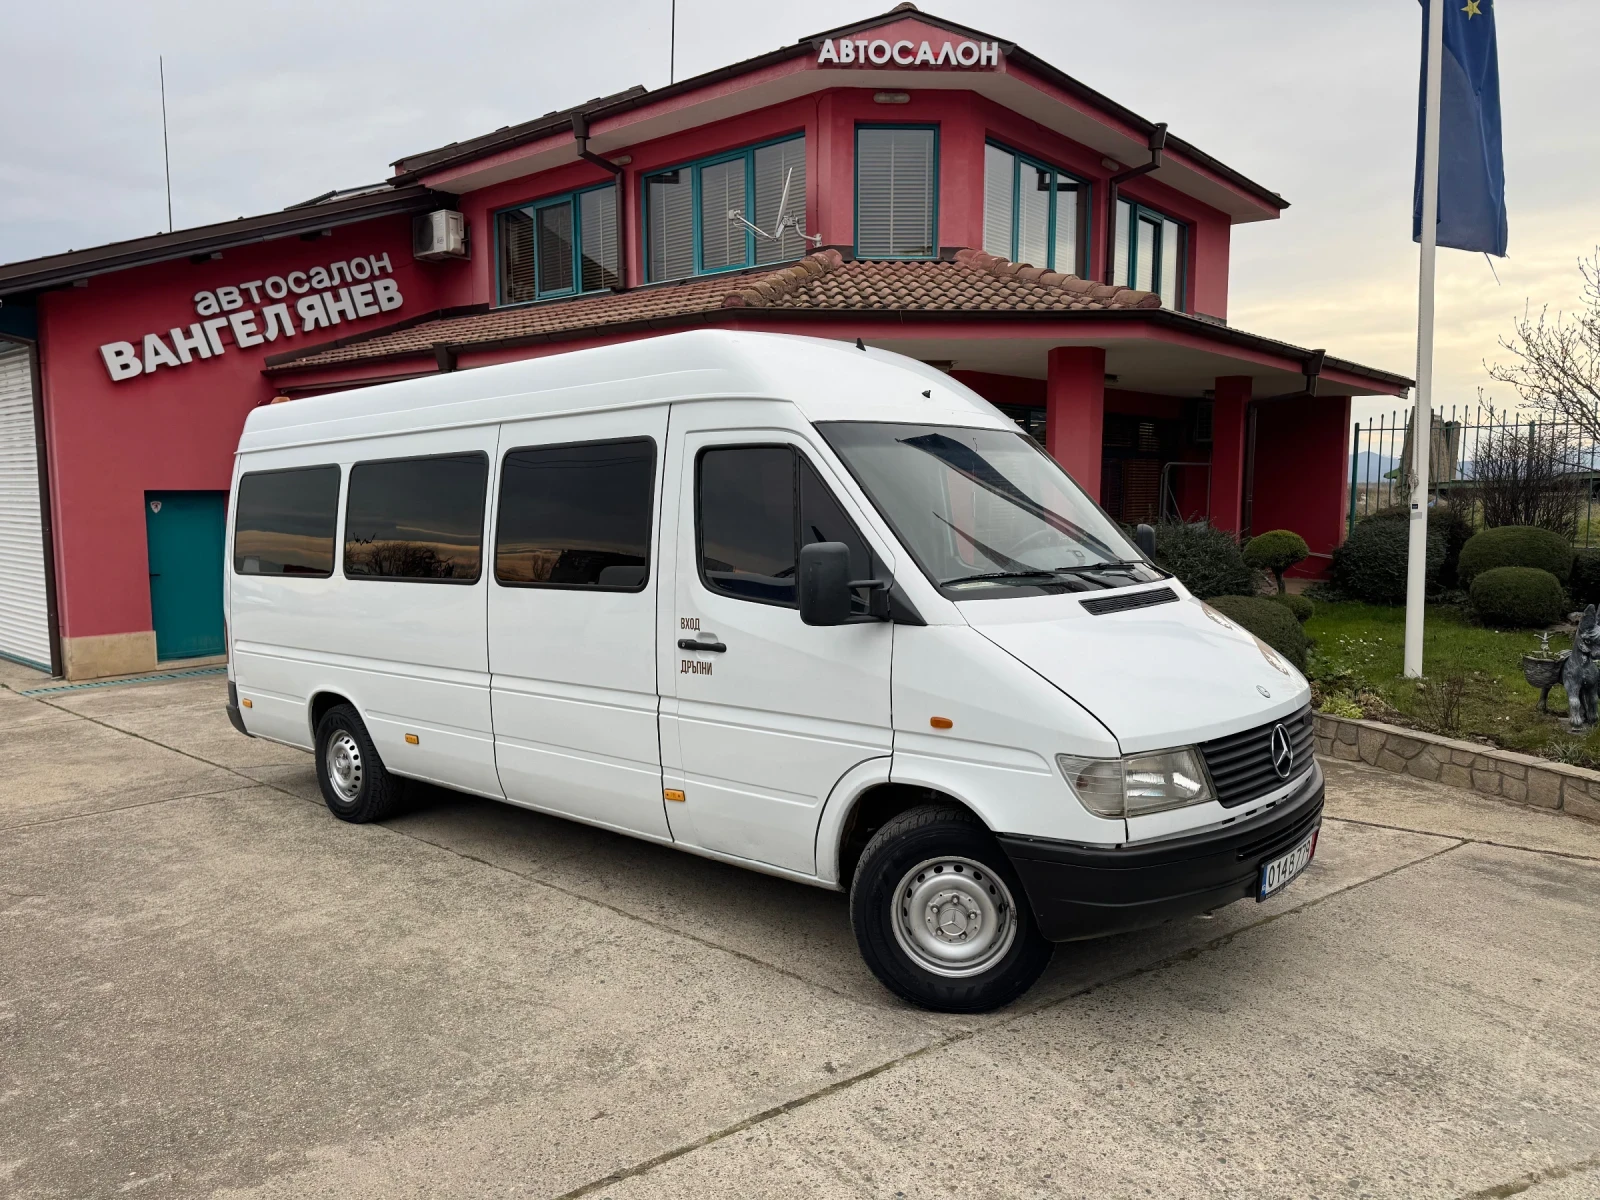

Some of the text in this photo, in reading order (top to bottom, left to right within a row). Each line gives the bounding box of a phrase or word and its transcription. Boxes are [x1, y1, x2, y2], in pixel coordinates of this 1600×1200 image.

[817, 38, 999, 66] АВТОСАЛОН
[194, 252, 393, 317] автосалон
[100, 278, 404, 382] ВАНГЕЛ ЯНЕВ
[680, 617, 701, 631] ВХОД
[680, 659, 713, 676] ДРЪПНИ
